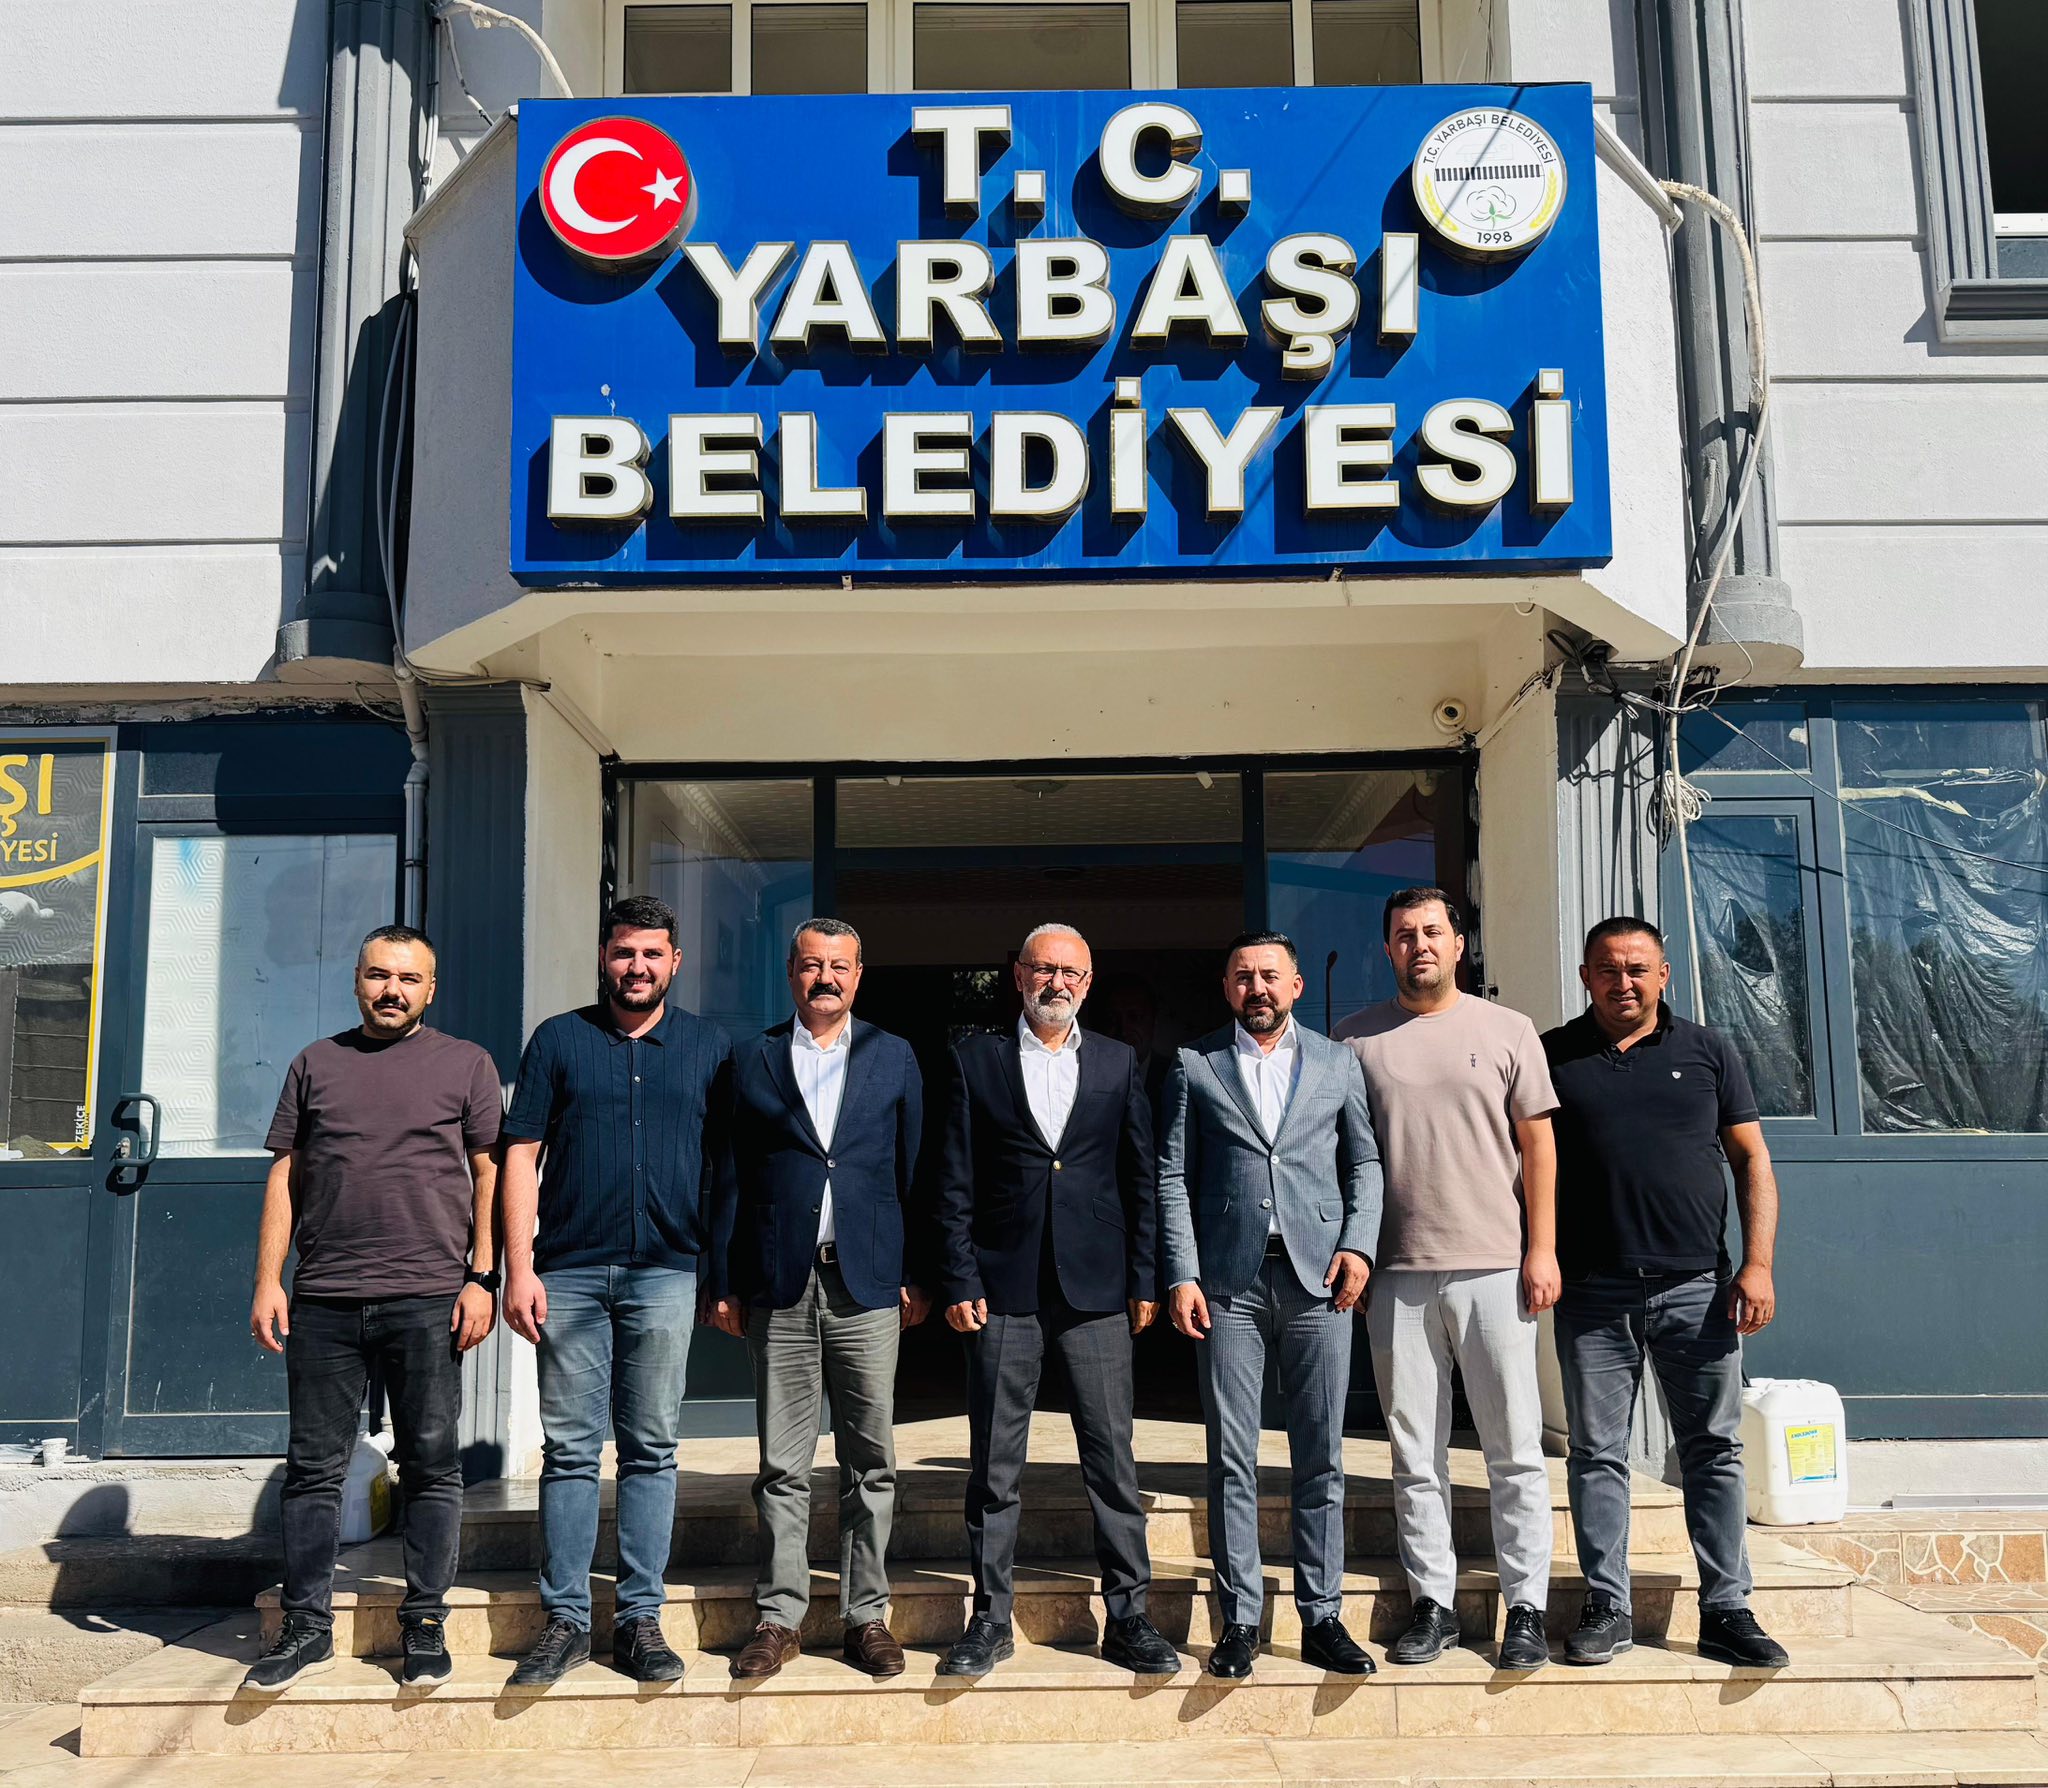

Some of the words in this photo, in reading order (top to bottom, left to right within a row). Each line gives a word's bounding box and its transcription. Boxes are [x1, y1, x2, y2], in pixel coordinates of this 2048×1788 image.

[1423, 146, 1440, 164] T.C.
[1434, 114, 1486, 144] YARBAŞI
[1491, 114, 1557, 164] BELEDİYESİ
[1477, 231, 1513, 244] 1998
[680, 232, 1419, 370] YARBAŞI
[547, 367, 1574, 520] BELEDİYESİ
[74, 1105, 86, 1142] ZEKİCE
